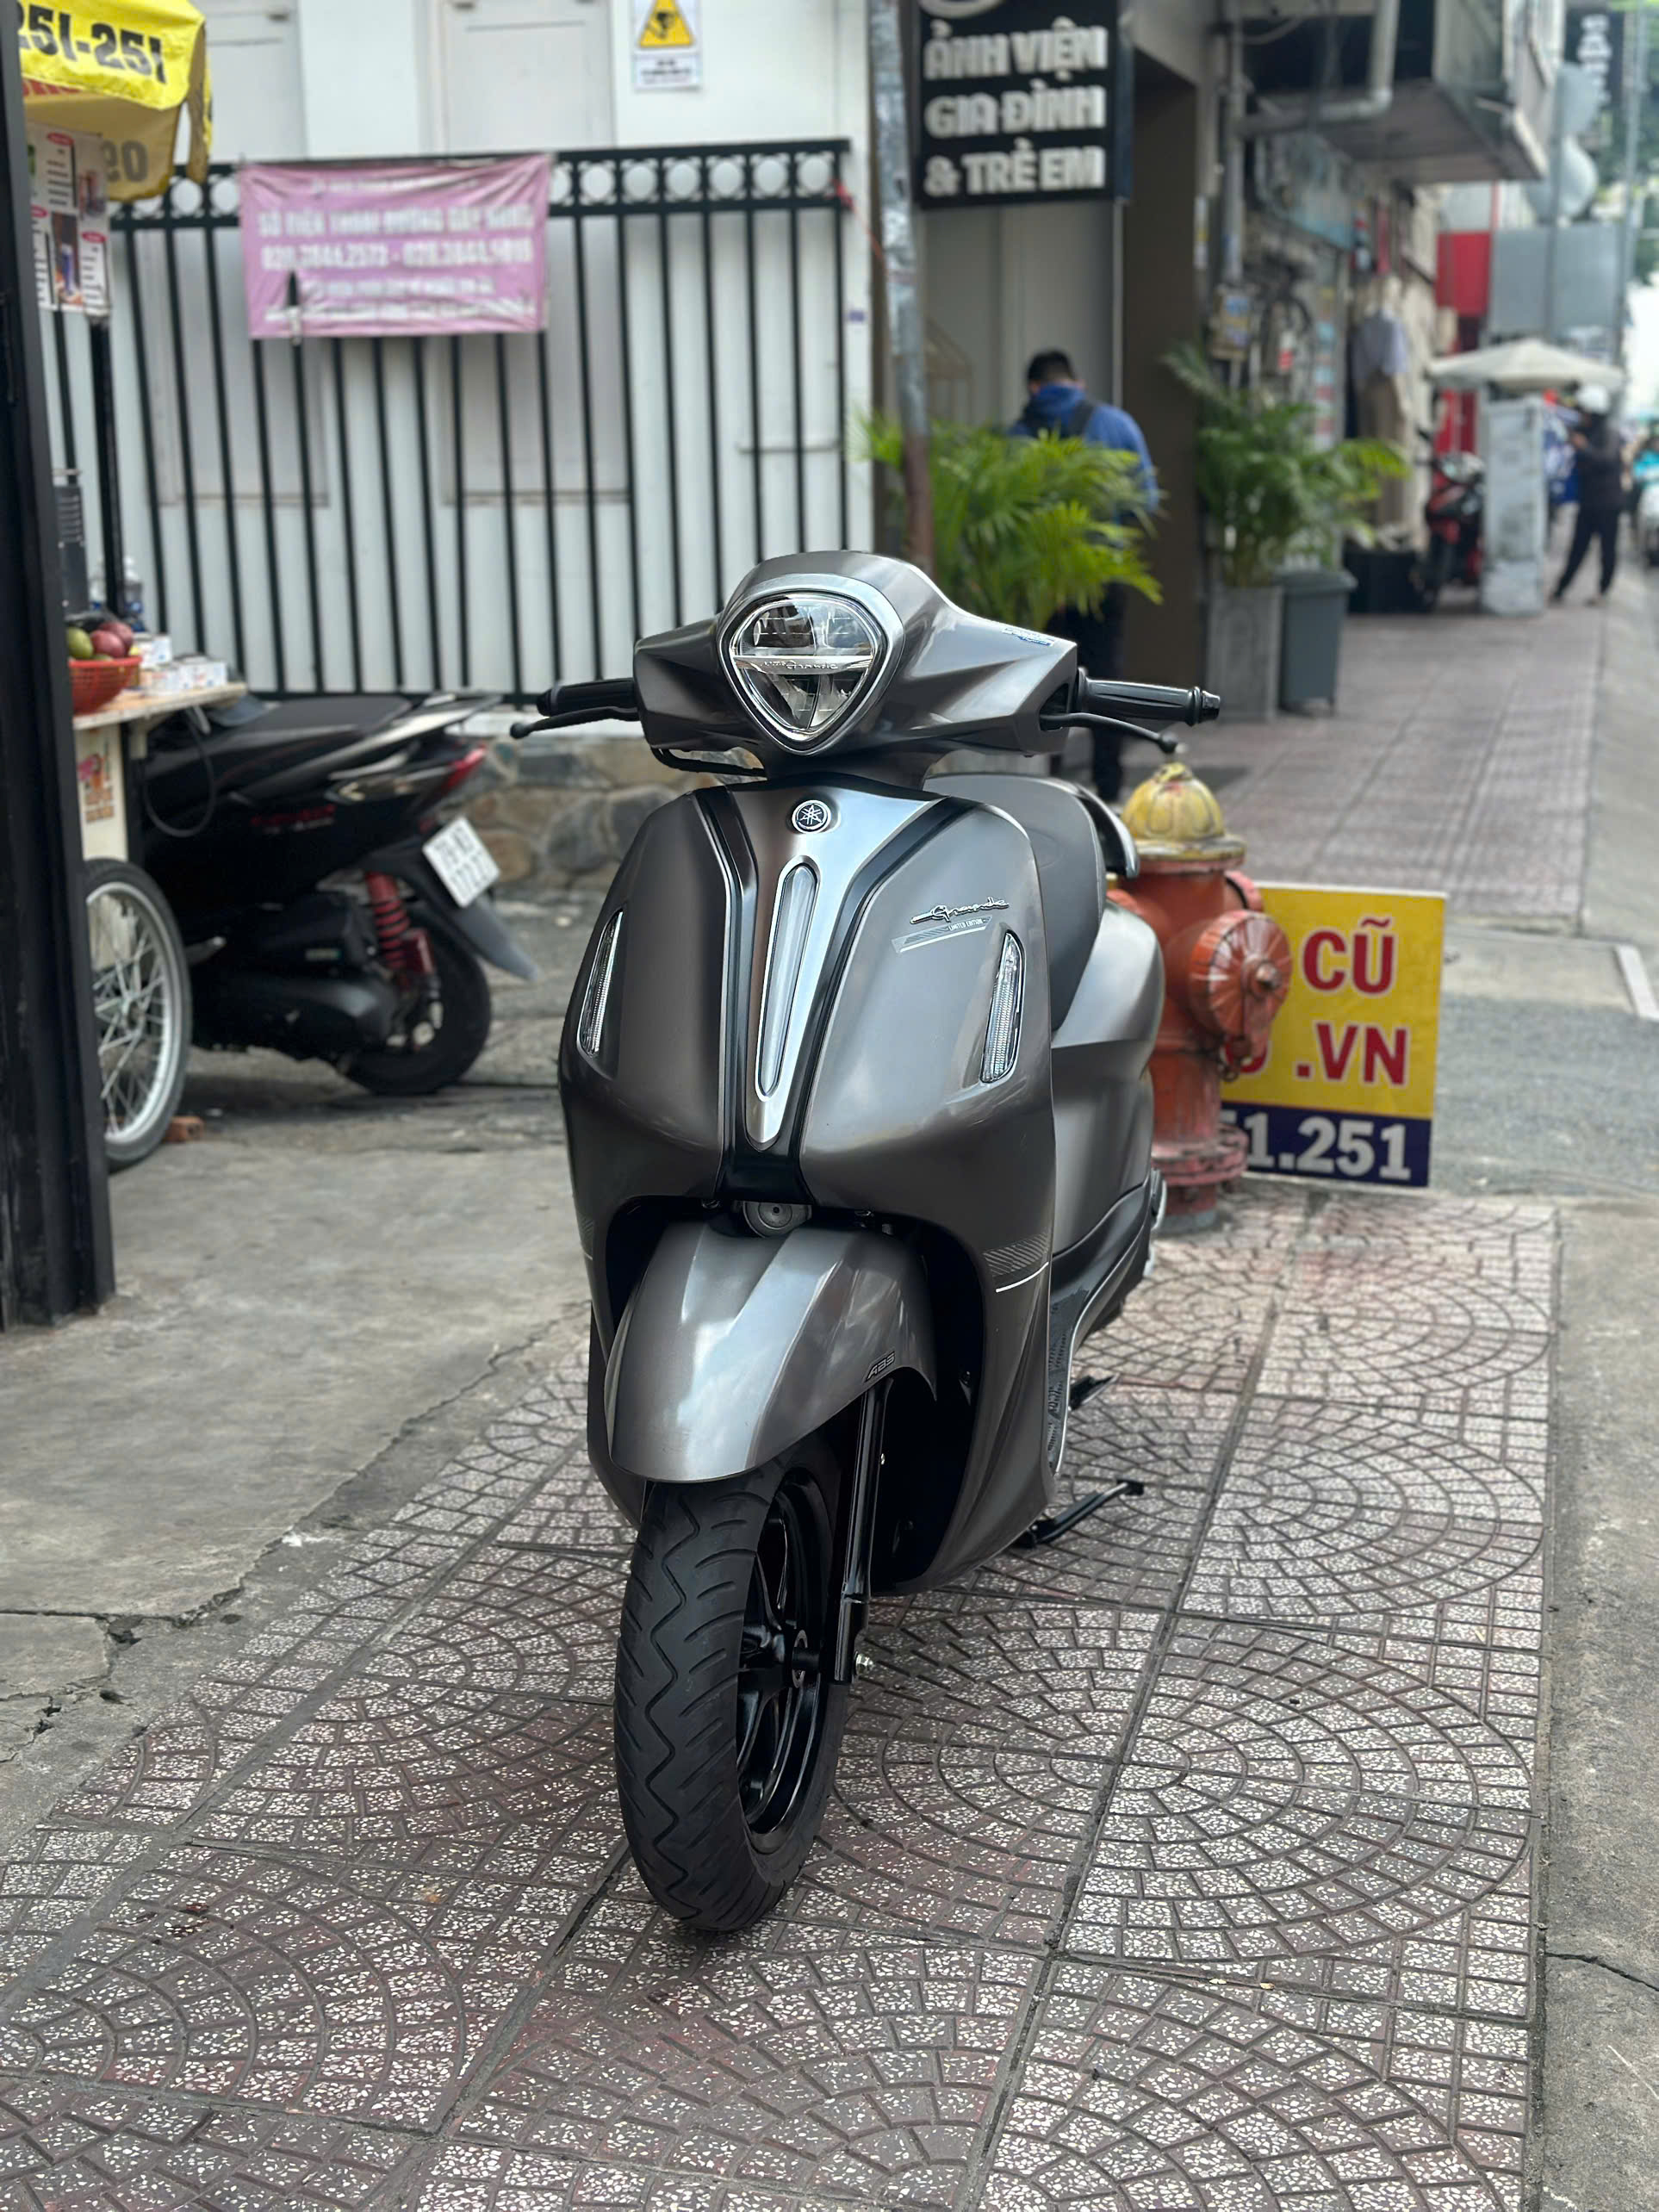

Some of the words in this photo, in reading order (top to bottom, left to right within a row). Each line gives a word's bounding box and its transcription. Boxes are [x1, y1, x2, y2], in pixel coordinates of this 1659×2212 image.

[923, 19, 1010, 80] ẢNH
[1010, 16, 1109, 82] VIỆN
[923, 92, 998, 139] GIA
[1000, 78, 1106, 134] ĐÌNH
[923, 155, 961, 197] &
[960, 137, 1036, 195] TRẺ
[1039, 145, 1106, 191] EM
[910, 897, 1010, 923] Grande
[948, 922, 966, 931] LIMITED
[966, 918, 983, 928] EDITION
[1302, 917, 1395, 994] CŨ
[1221, 1109, 1411, 1181] 1.251
[867, 1352, 895, 1380] ABS
